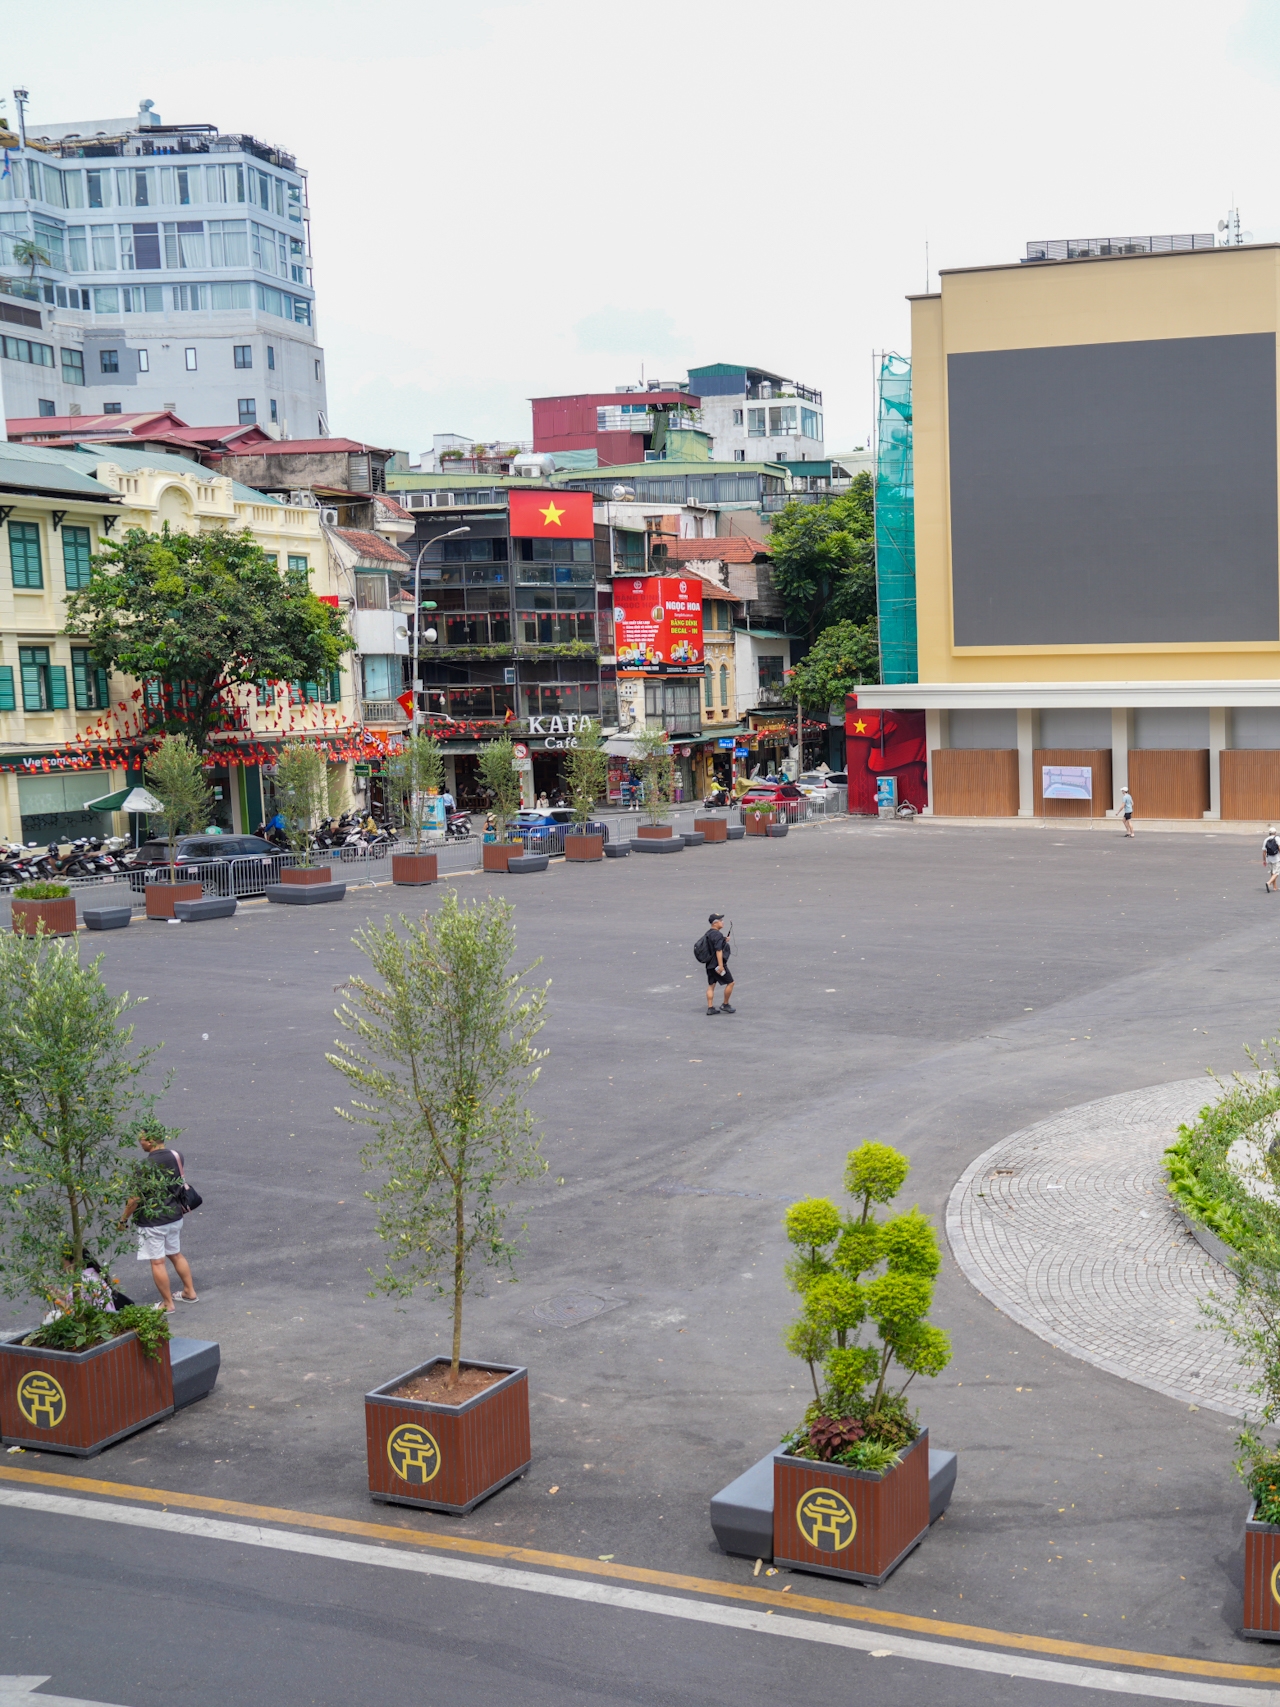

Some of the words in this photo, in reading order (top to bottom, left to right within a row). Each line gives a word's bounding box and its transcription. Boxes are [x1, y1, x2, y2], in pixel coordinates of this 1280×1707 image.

[666, 601, 686, 612] NGỌC
[687, 602, 701, 611] HOA
[527, 714, 593, 735] KAFA
[544, 737, 578, 749] Café
